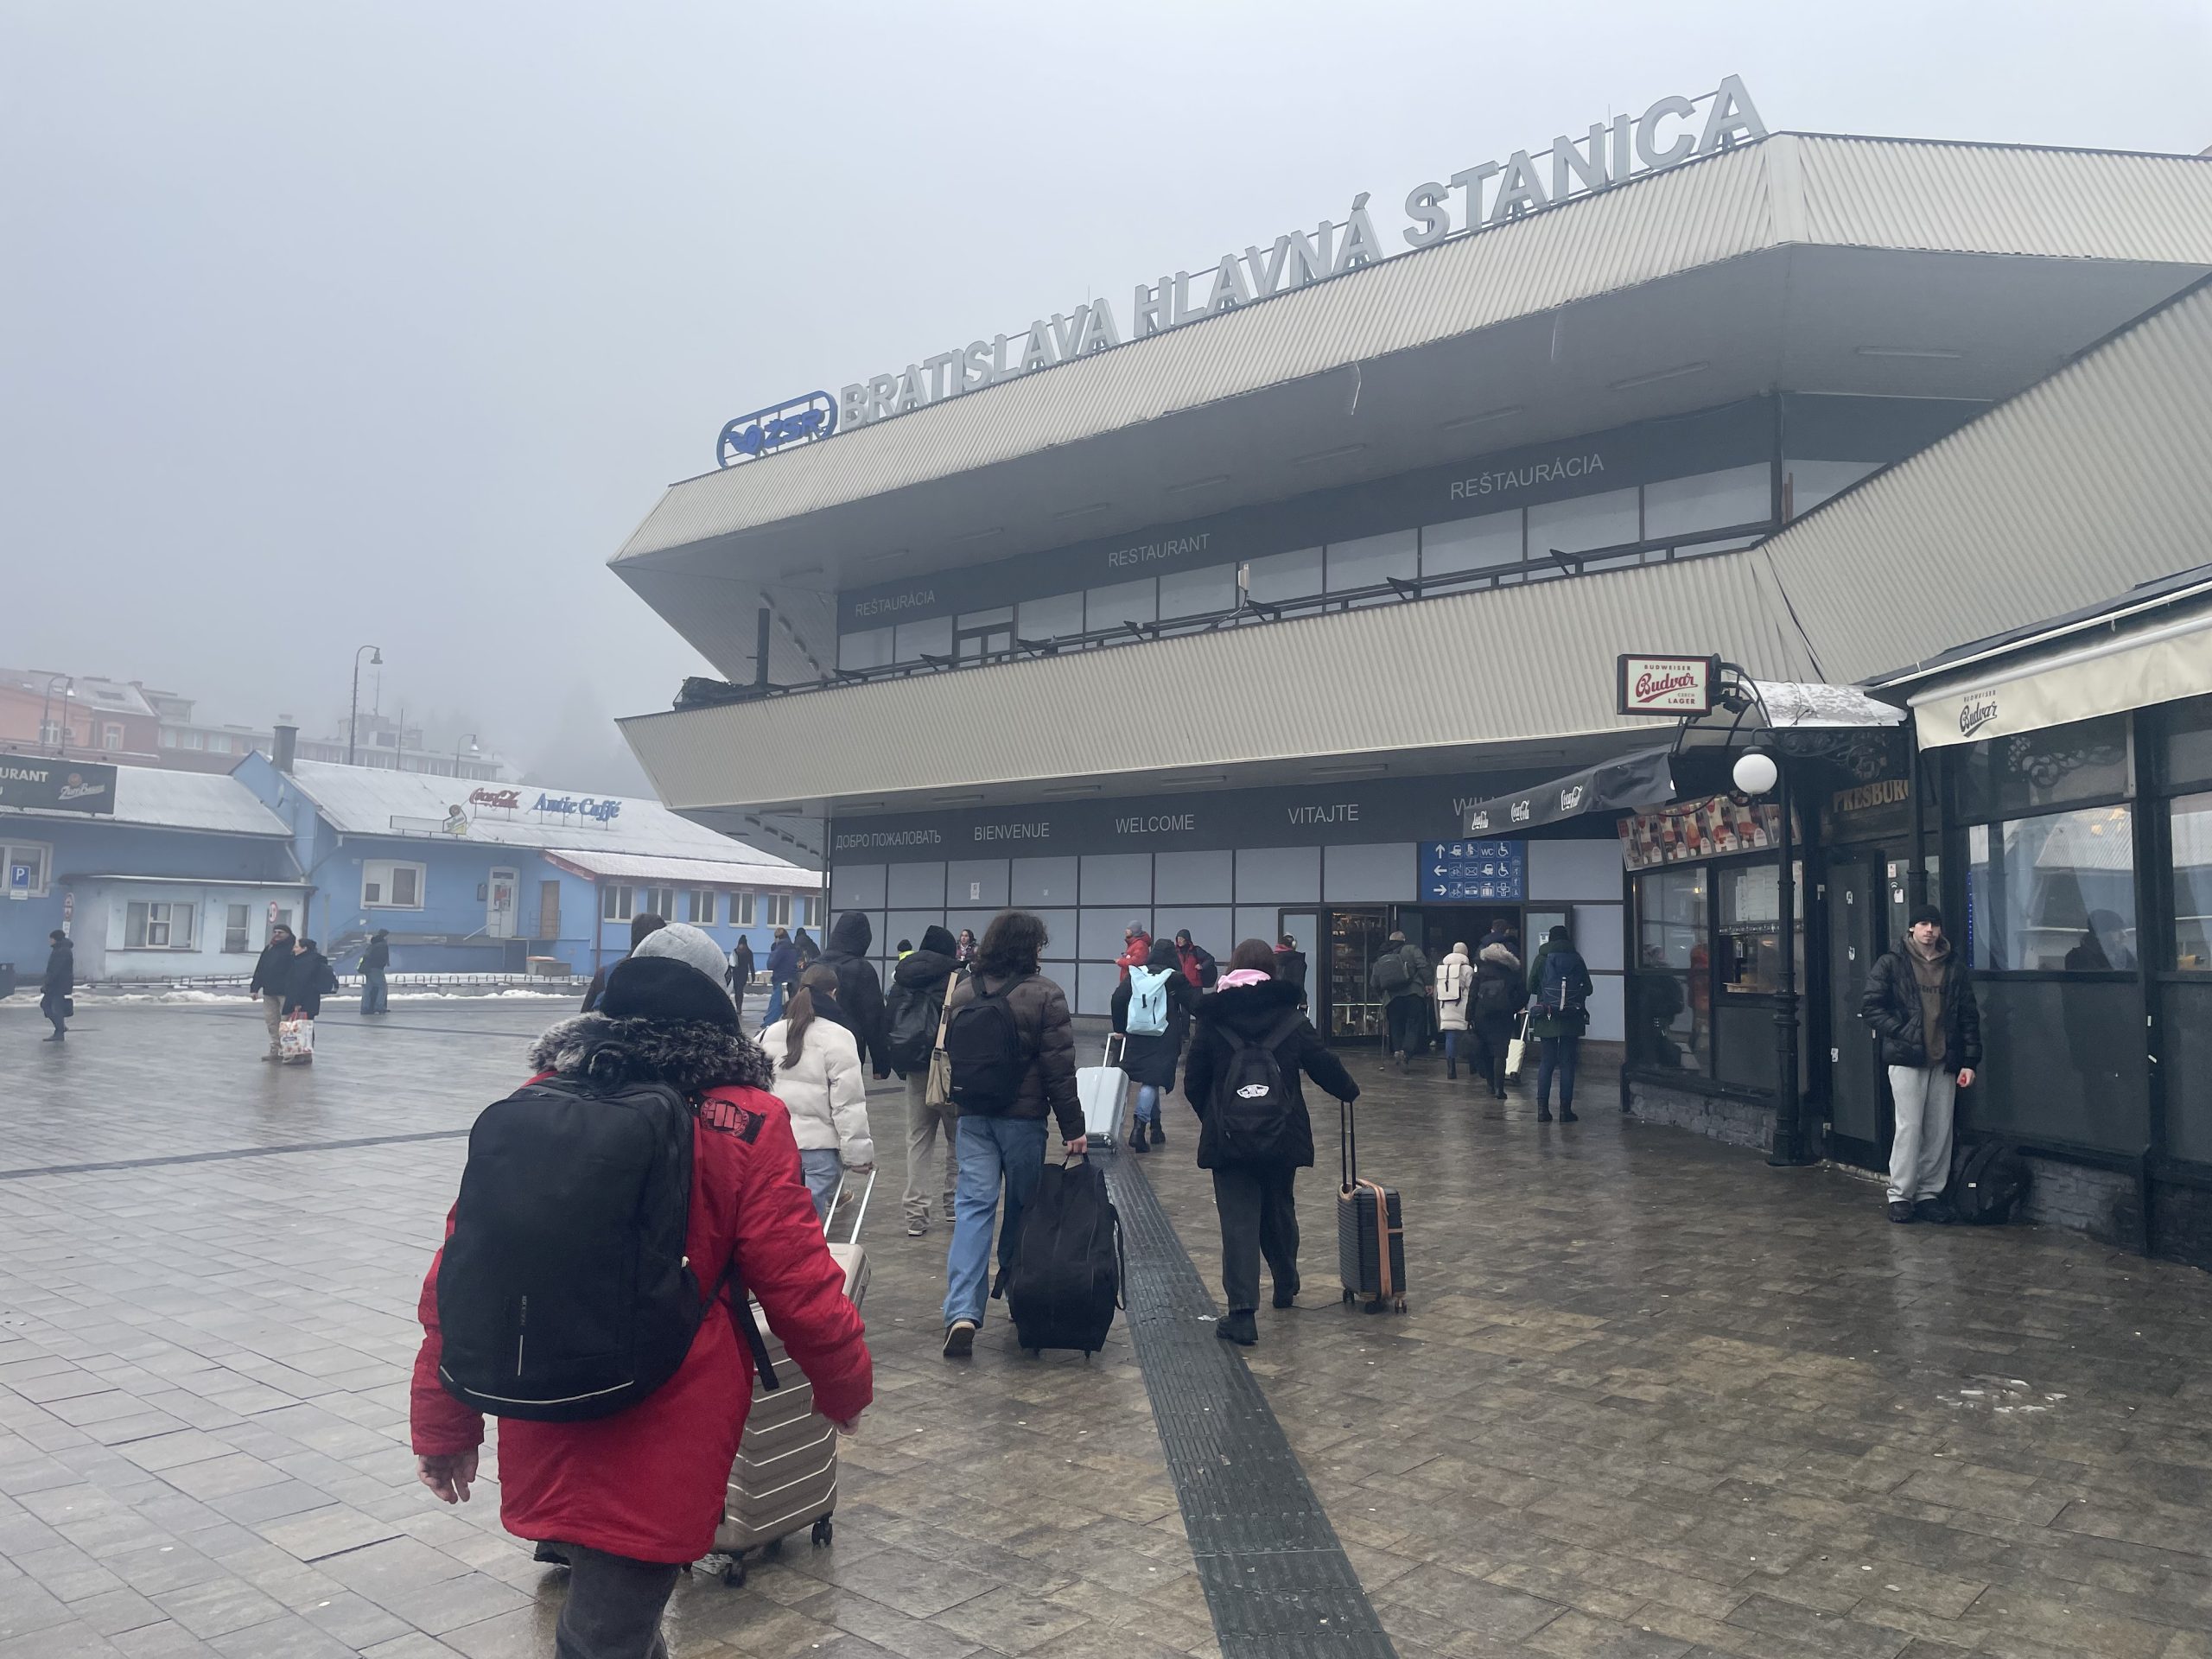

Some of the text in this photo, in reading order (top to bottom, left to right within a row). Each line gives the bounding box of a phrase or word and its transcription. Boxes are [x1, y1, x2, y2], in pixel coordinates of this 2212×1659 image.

[840, 73, 1768, 432] BRATISLAVA HLAVNÁ STANICA
[1451, 454, 1605, 500] REŠTAURÁCIA
[1109, 532, 1211, 567] RESTAURANT
[855, 588, 936, 618] REŠTAURÁCIA
[1636, 672, 1699, 702] Budvar
[1960, 701, 1998, 738] Budvar
[533, 793, 622, 821] Antic Caffé
[1287, 804, 1359, 824] VITAJTE
[974, 823, 1051, 841] BIENVENUE
[1116, 814, 1195, 834] WELCOME
[836, 830, 942, 850] ДОБРО ПОЖАЛОВАТЬ
[1481, 848, 1494, 856] WC
[16, 868, 25, 881] P
